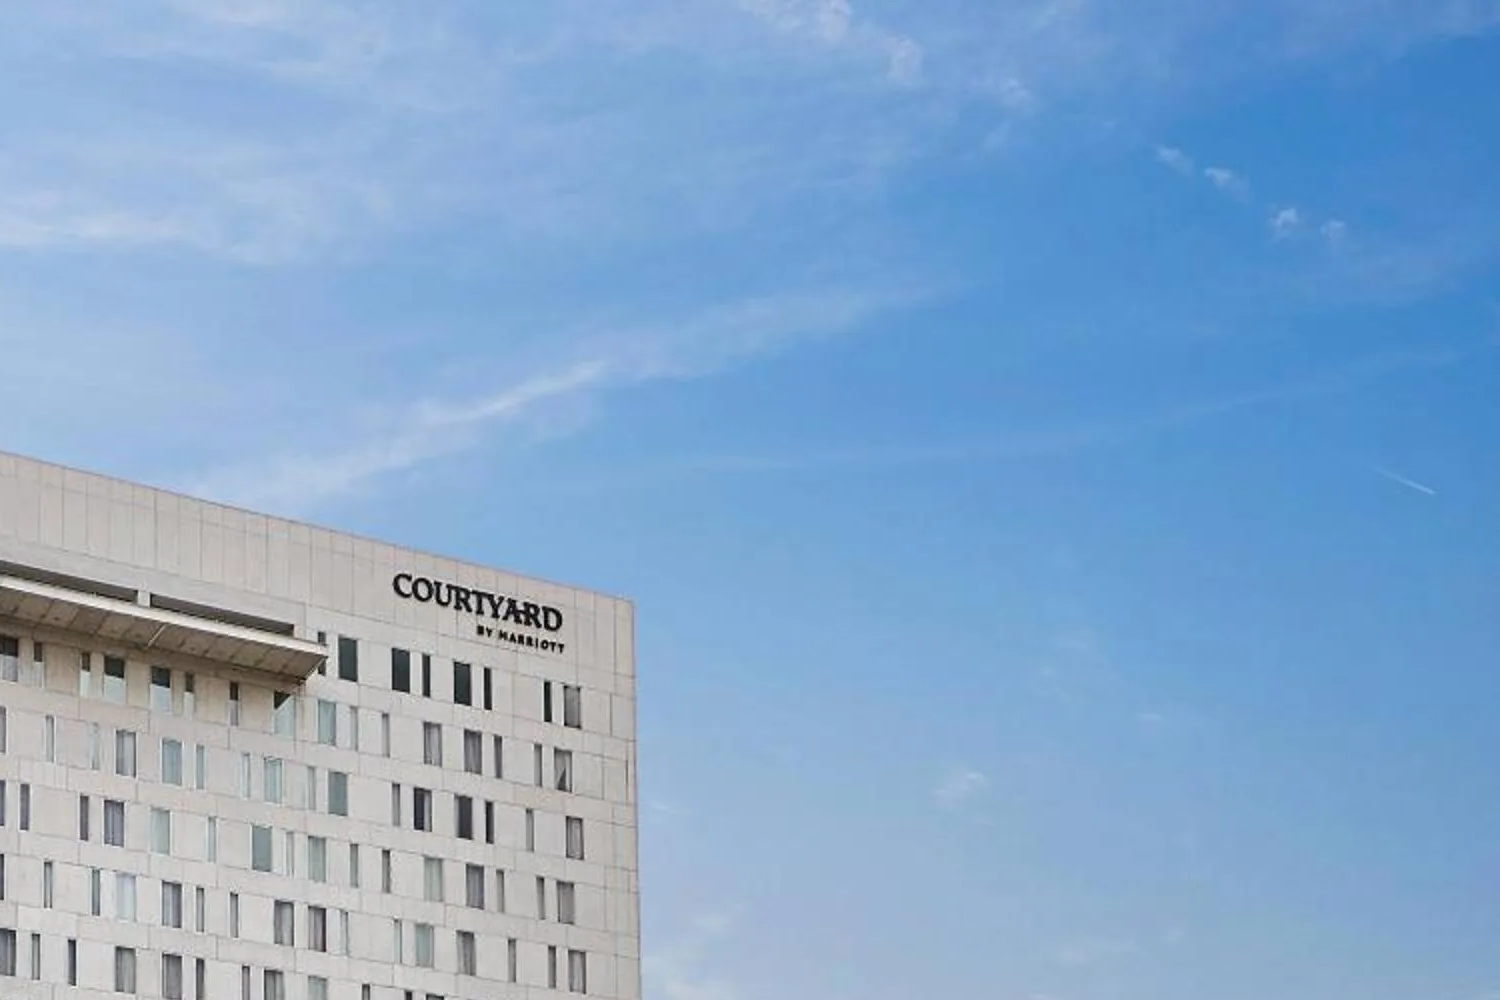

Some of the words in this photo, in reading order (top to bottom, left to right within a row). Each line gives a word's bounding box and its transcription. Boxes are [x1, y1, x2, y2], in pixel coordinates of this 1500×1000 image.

[393, 573, 563, 631] COURTYARD
[476, 625, 493, 638] BY
[499, 629, 565, 654] MARRIOTT
